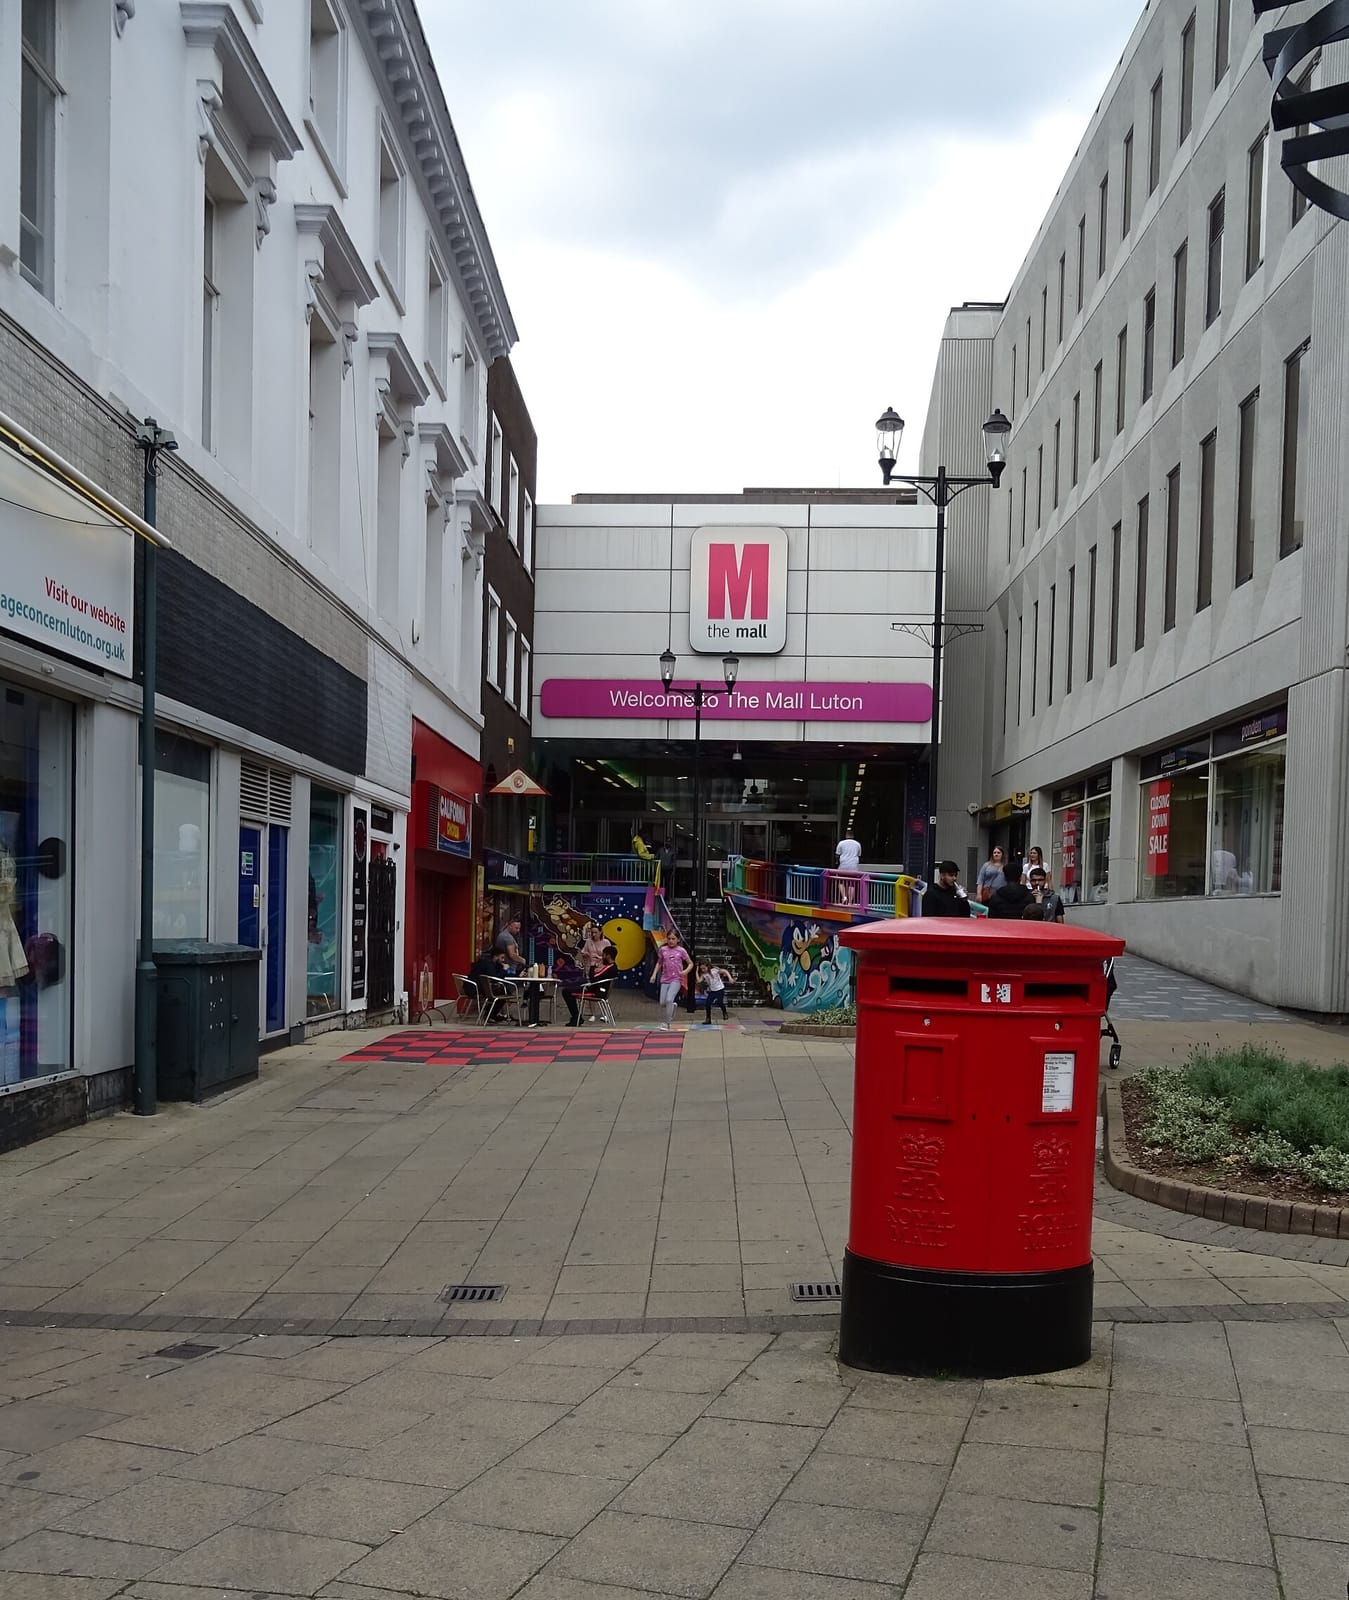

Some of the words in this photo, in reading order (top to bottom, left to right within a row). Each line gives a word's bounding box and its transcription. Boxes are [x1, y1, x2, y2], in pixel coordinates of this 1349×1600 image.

[707, 543, 770, 620] M
[45, 576, 69, 606] Visit
[71, 595, 88, 615] our
[90, 604, 125, 633] website
[0, 593, 125, 661] ageconcernluton.org.uk
[707, 623, 730, 638] the
[736, 623, 768, 639] mall
[609, 690, 696, 708] Welcome
[724, 692, 760, 708] The
[765, 692, 804, 709] Mall
[810, 693, 863, 710] Luton
[1150, 793, 1170, 811] CLOSING
[1151, 812, 1168, 829] DOWN
[1149, 834, 1168, 855] SALE
[1062, 851, 1075, 868] SALE
